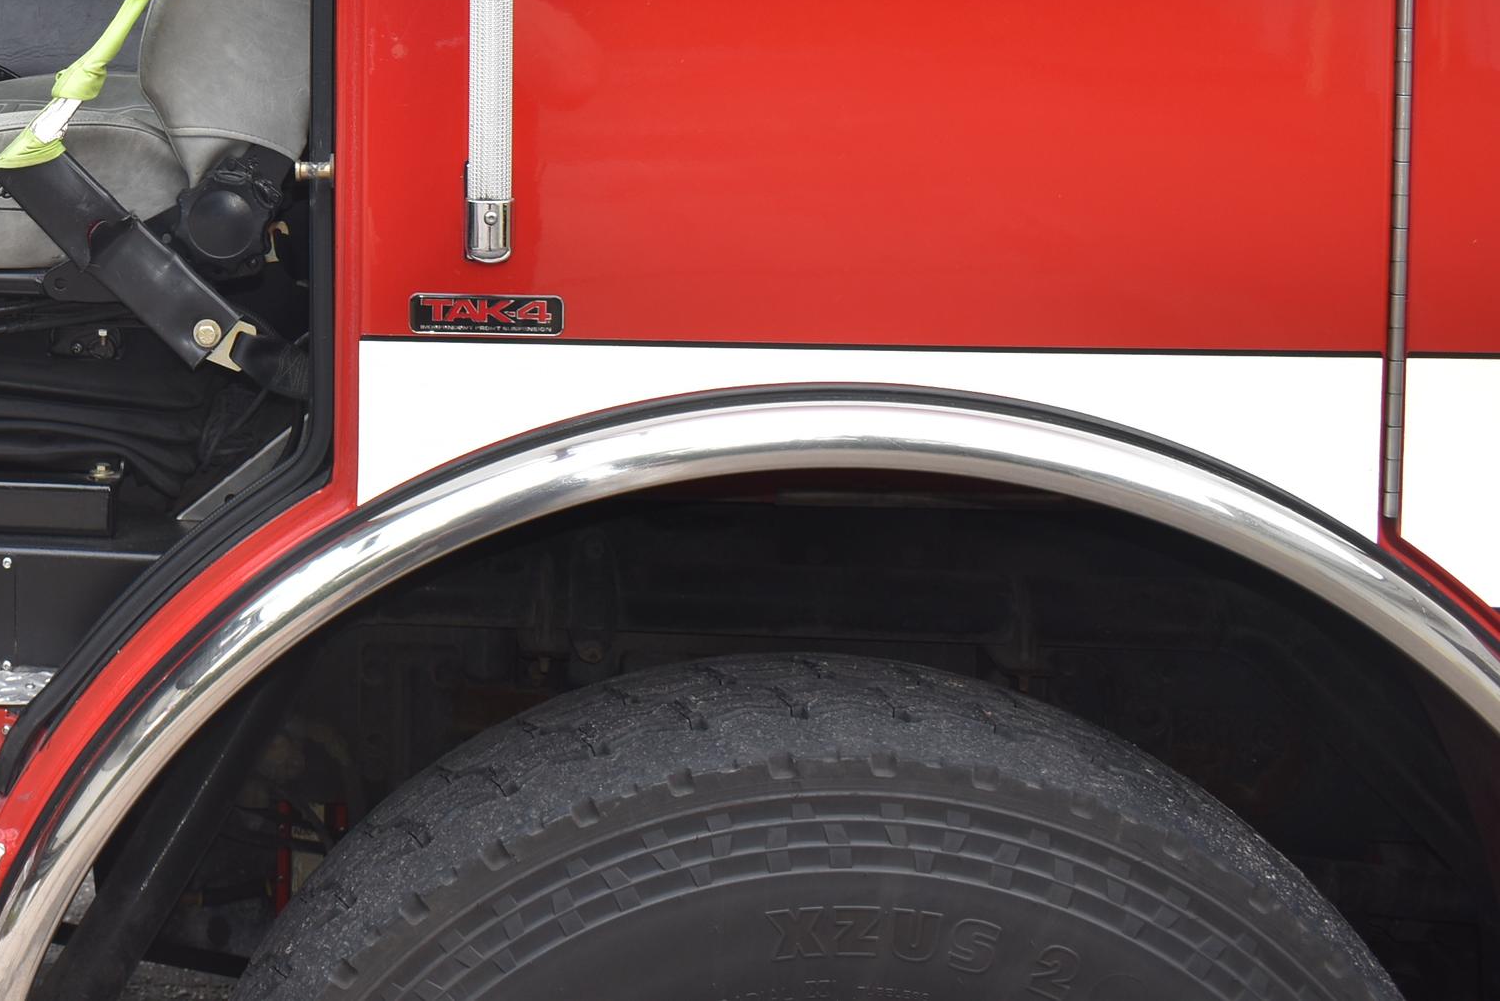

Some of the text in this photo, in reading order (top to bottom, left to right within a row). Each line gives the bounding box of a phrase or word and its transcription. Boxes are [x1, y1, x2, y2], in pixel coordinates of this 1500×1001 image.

[420, 298, 552, 324] TAK-4
[765, 905, 1081, 1000] XZUS 2
